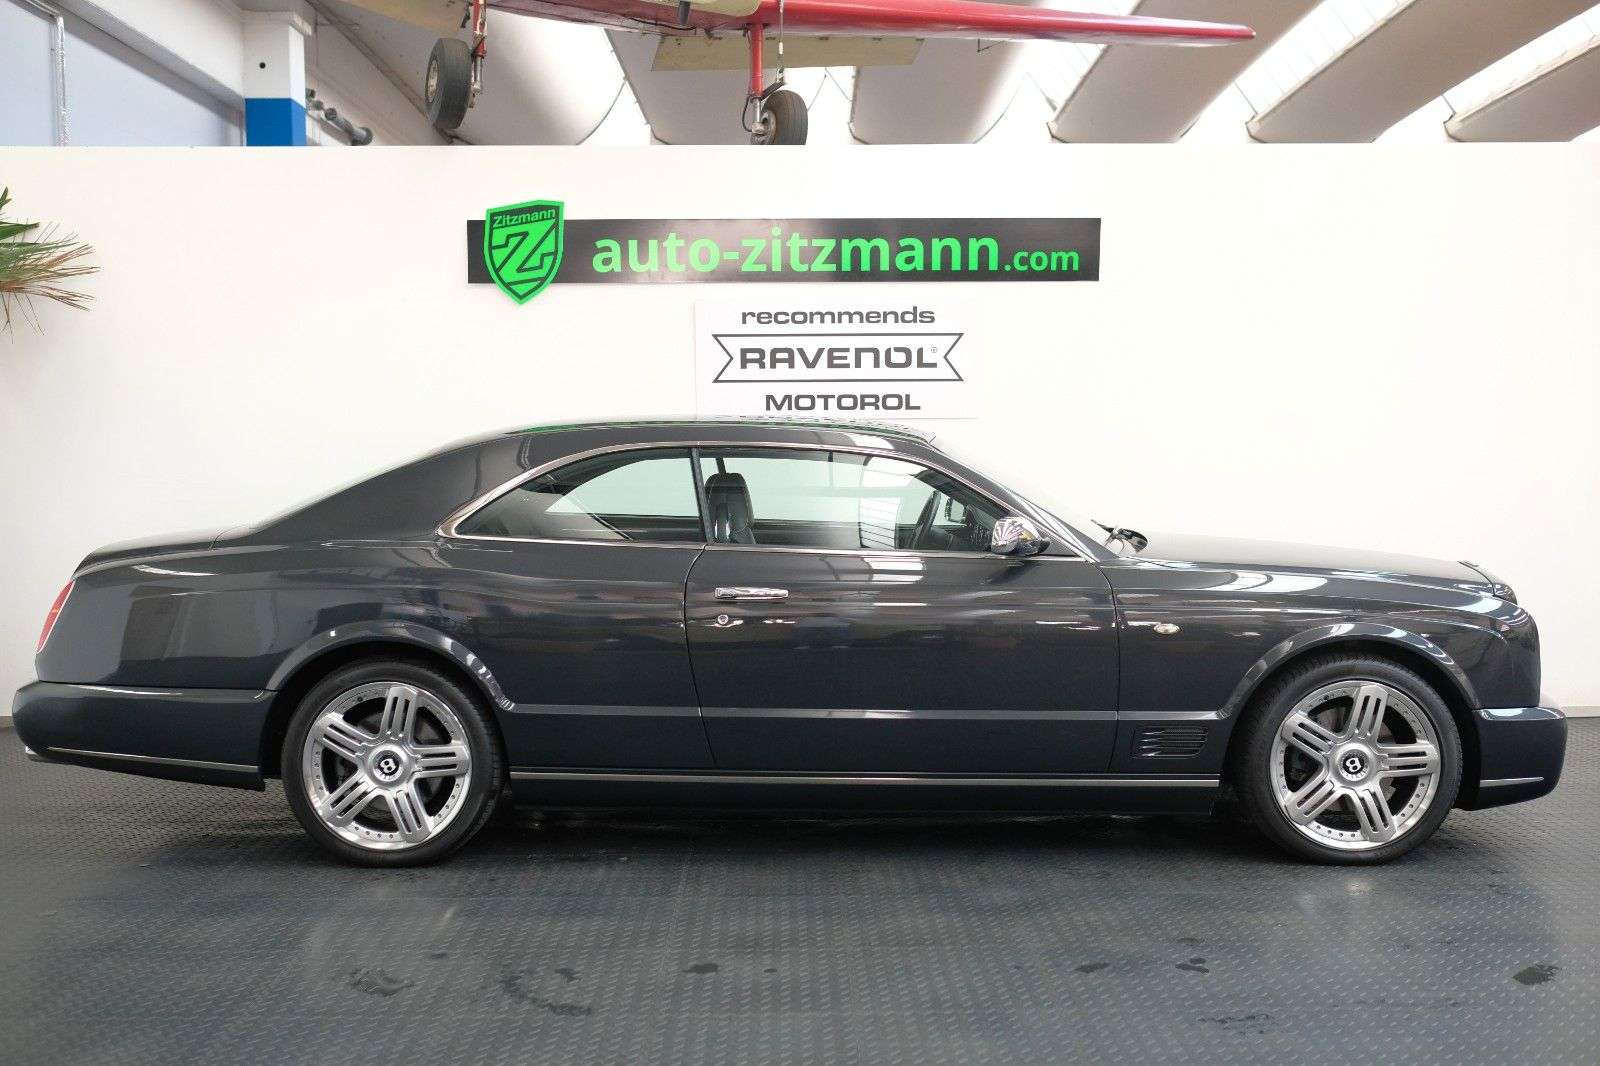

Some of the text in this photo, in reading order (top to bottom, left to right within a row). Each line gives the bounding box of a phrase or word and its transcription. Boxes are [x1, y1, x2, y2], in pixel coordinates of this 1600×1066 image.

[493, 209, 556, 227] Zitzmann
[592, 227, 1080, 274] auto-zitzmann.com
[741, 306, 935, 325] recommends
[765, 394, 921, 411] MOTOROL
